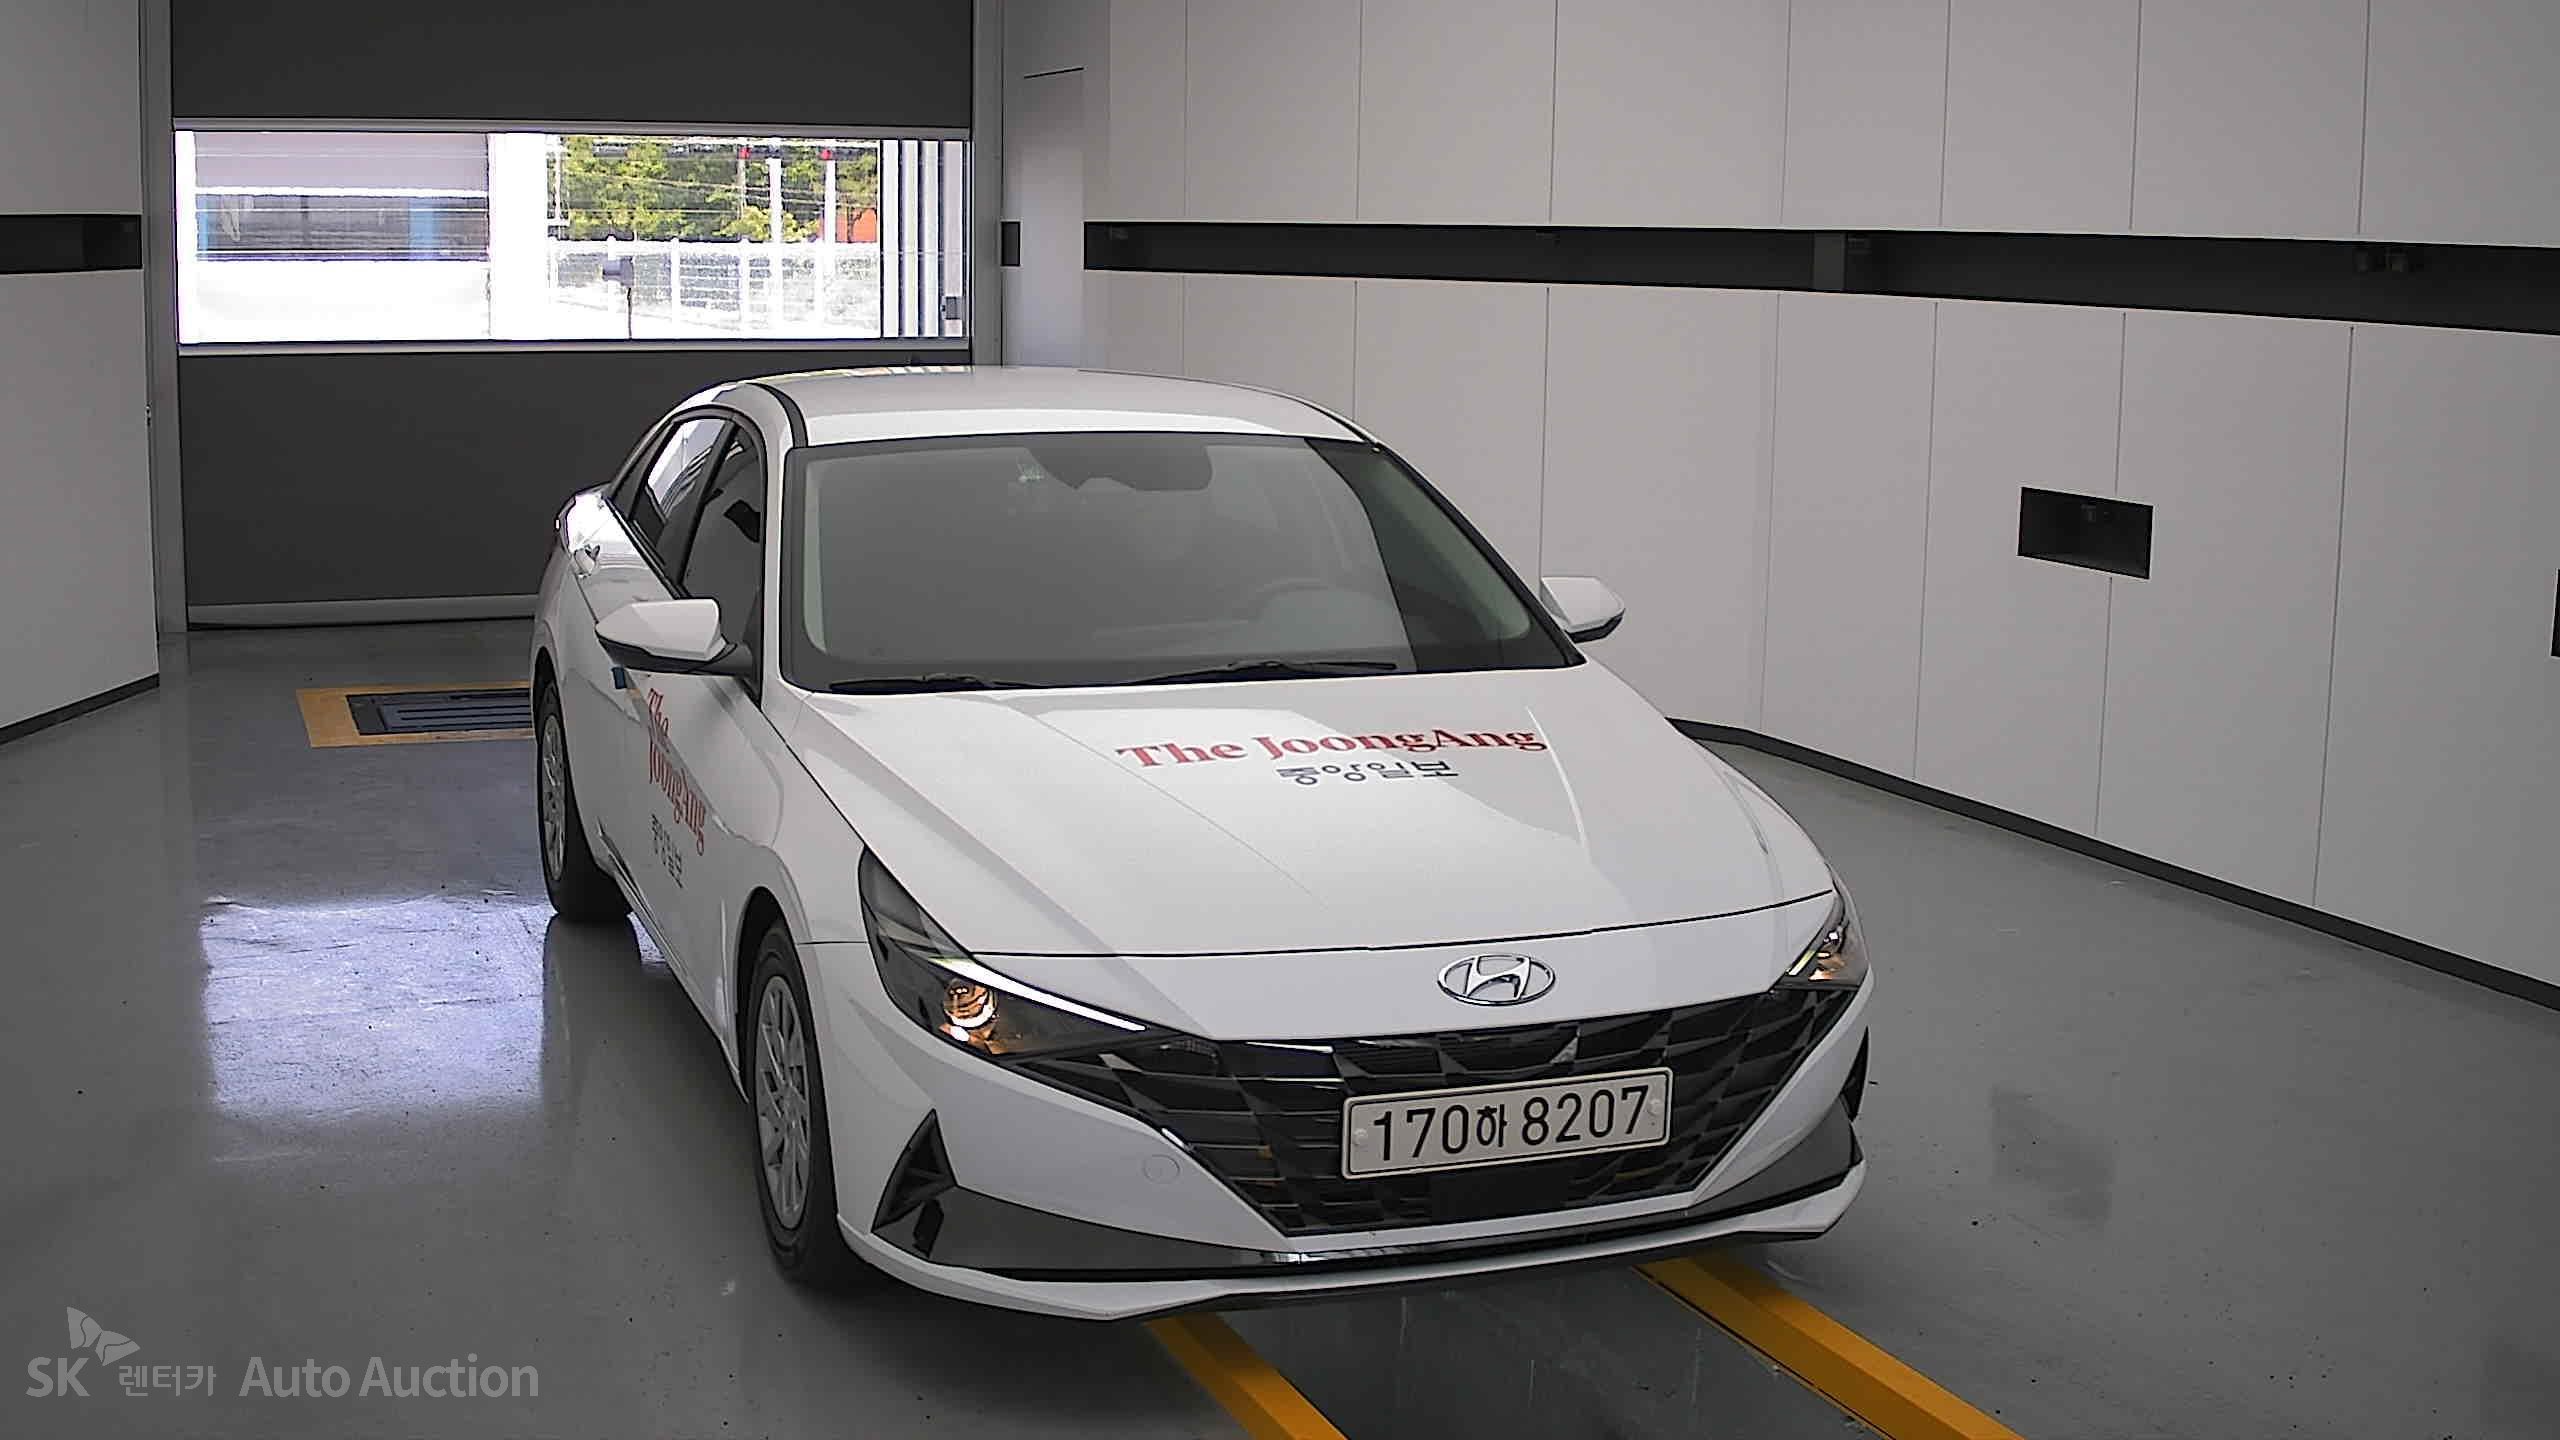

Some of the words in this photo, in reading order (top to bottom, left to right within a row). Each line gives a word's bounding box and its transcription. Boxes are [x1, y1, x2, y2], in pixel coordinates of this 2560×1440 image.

[1116, 738, 1248, 768] The
[1252, 728, 1548, 760] JoongAng
[1277, 760, 1459, 786] 중앙일보
[1373, 1103, 1507, 1162] 170하
[1521, 1085, 1649, 1146] 8207
